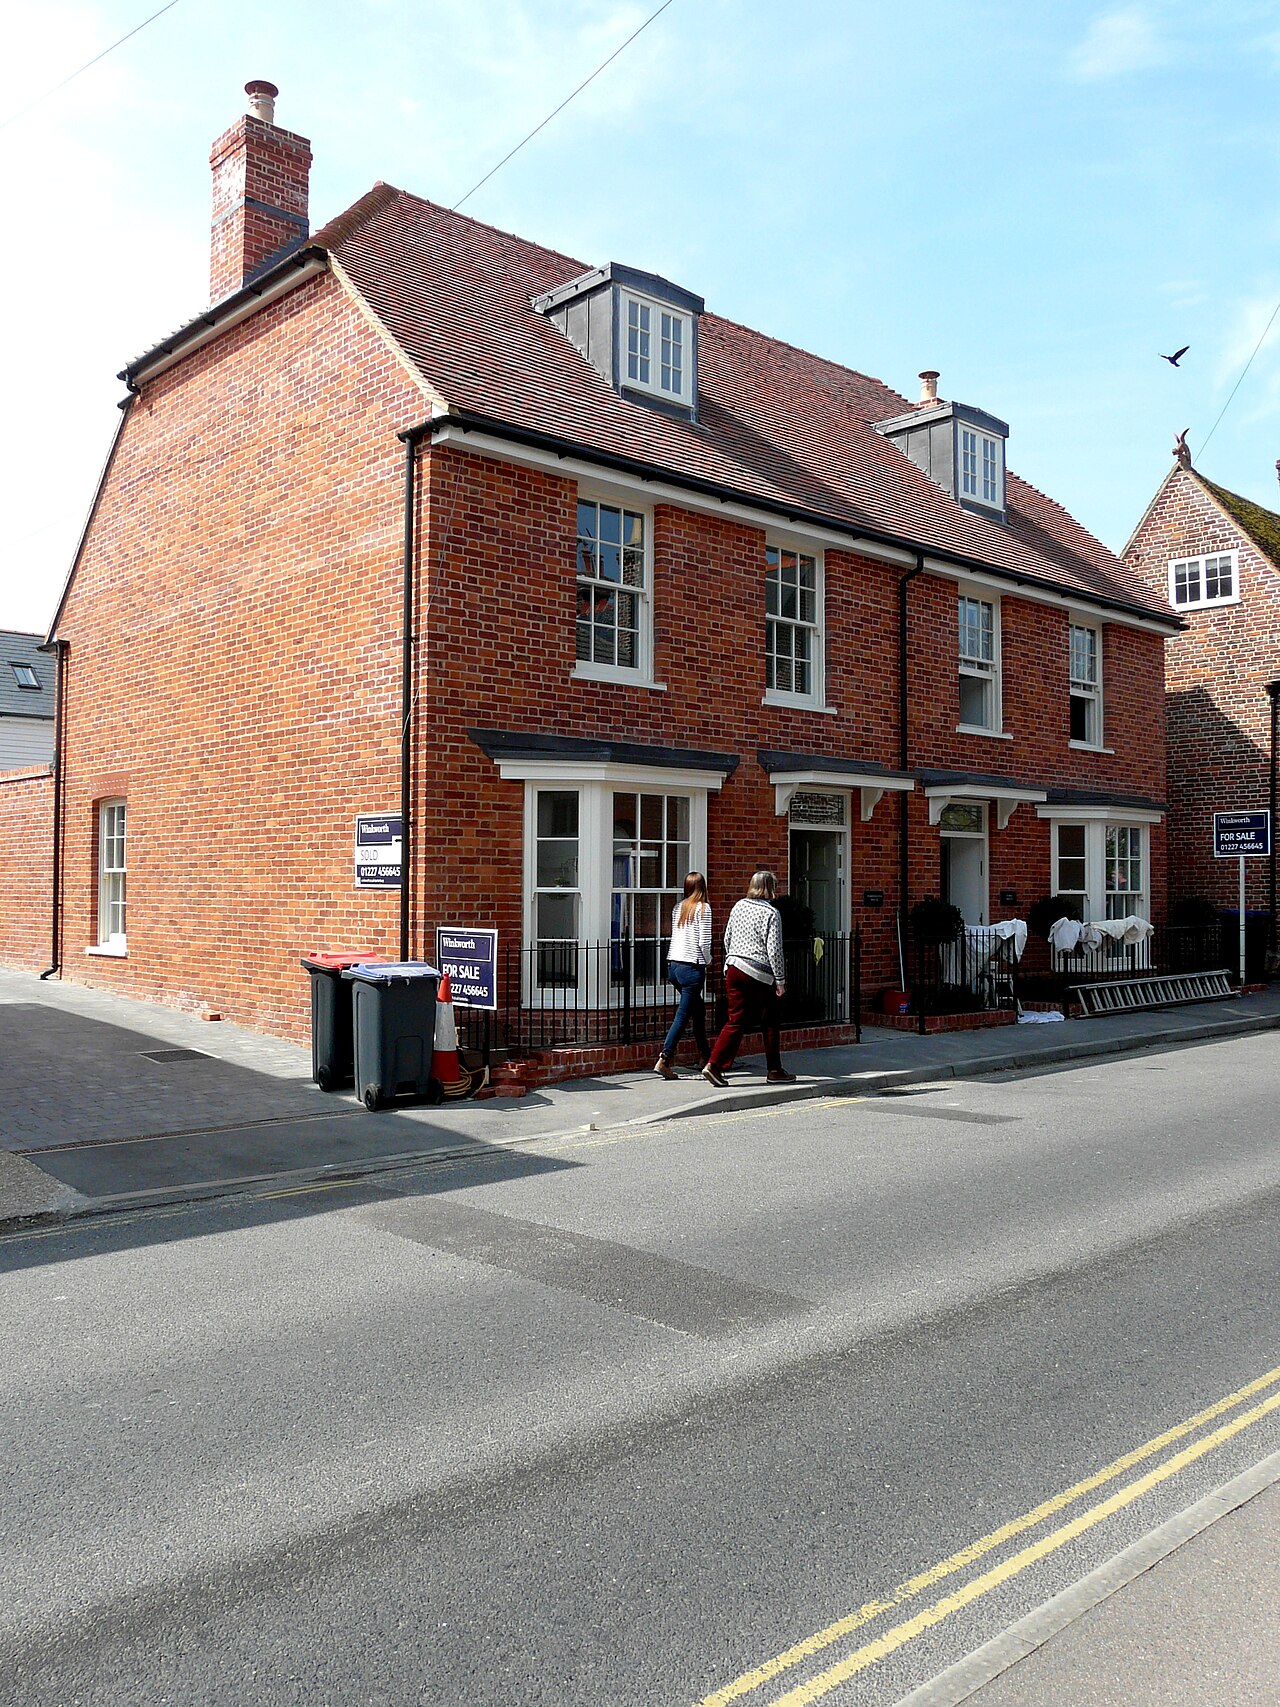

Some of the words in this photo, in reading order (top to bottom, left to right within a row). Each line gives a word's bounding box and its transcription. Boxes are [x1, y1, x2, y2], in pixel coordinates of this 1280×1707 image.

[1220, 816, 1251, 824] Winkworth
[1220, 833, 1235, 841] FOR
[1236, 832, 1256, 841] SALE
[1239, 842, 1264, 850] 456645
[360, 849, 379, 861] SOLD
[360, 866, 378, 877] 01227
[378, 866, 401, 877] 456645
[442, 937, 476, 949] Winkworth
[442, 963, 458, 978] FOR
[458, 965, 480, 980] SALE
[450, 983, 462, 994] 227
[462, 983, 489, 998] 456645
